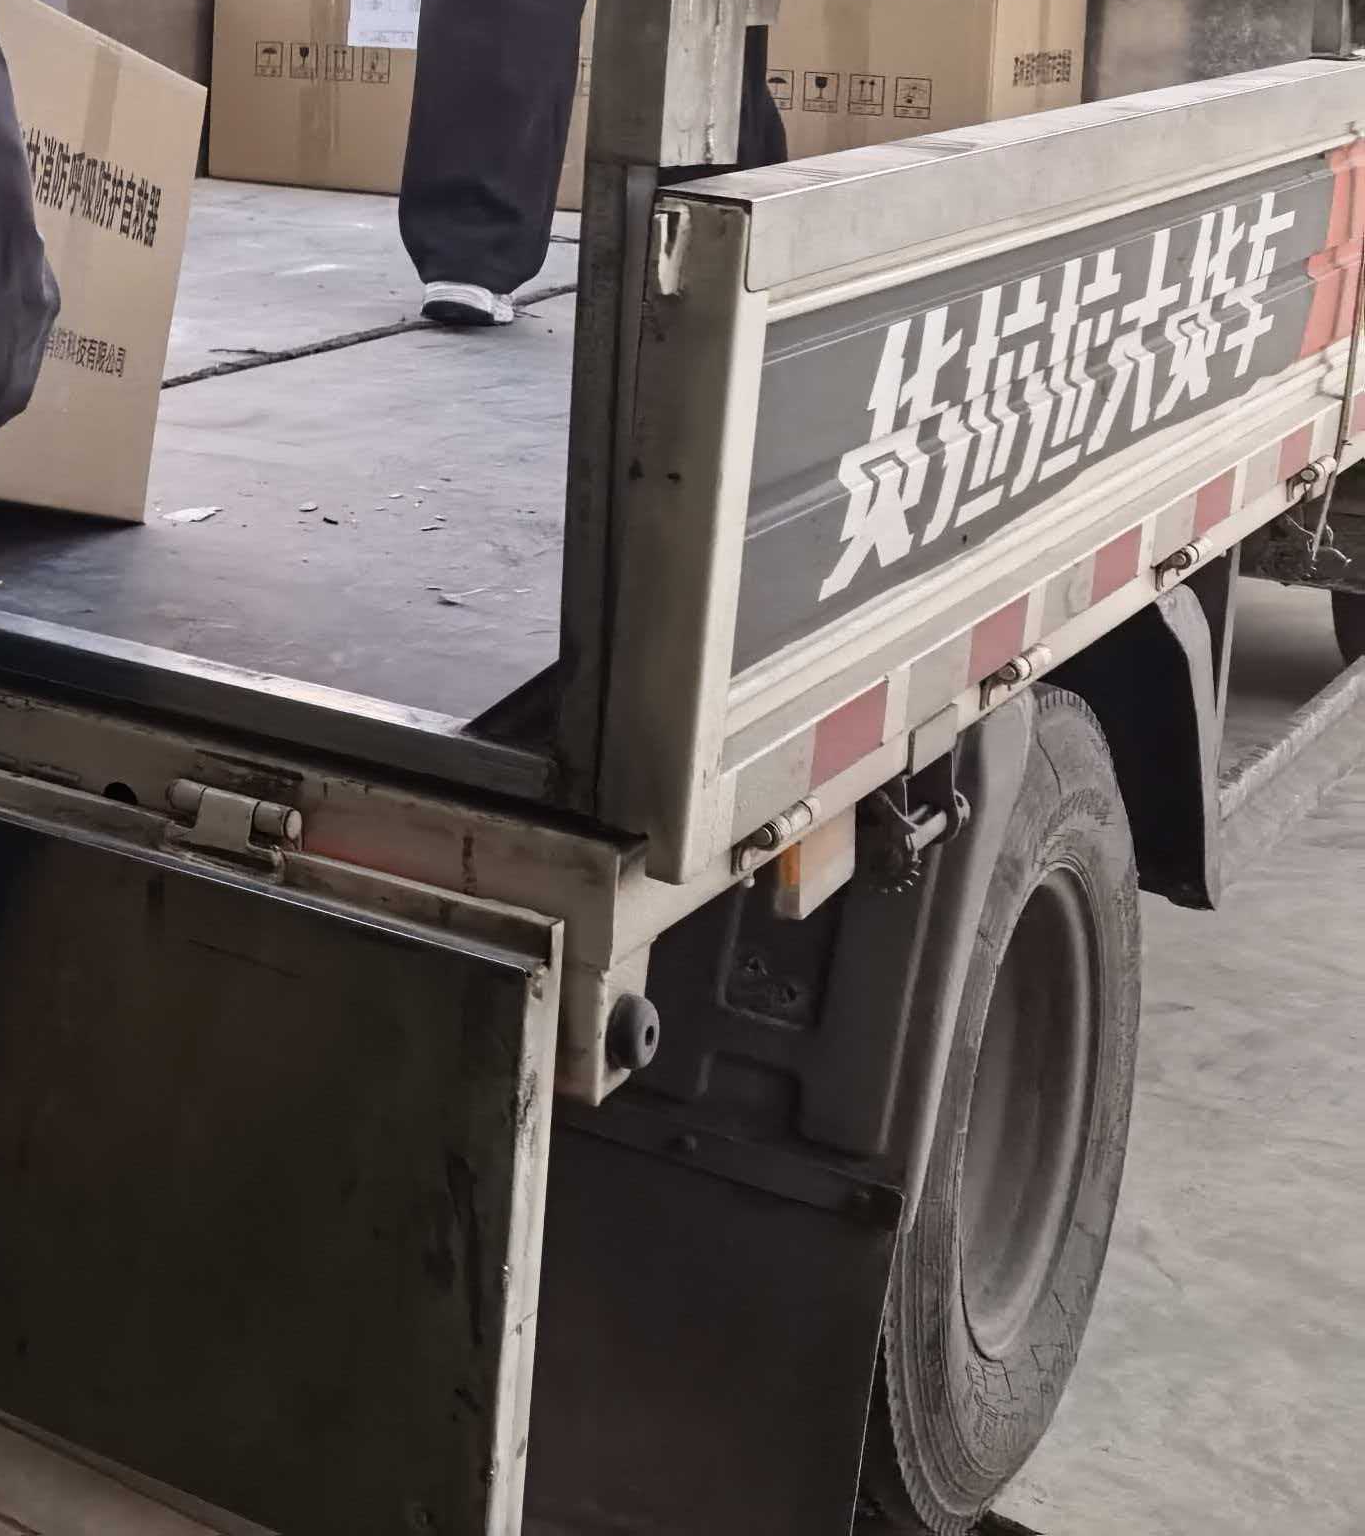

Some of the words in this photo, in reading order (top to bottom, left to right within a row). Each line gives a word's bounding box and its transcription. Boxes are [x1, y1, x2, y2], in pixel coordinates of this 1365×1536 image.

[23, 127, 161, 249] 林消防呼吸防护自救器
